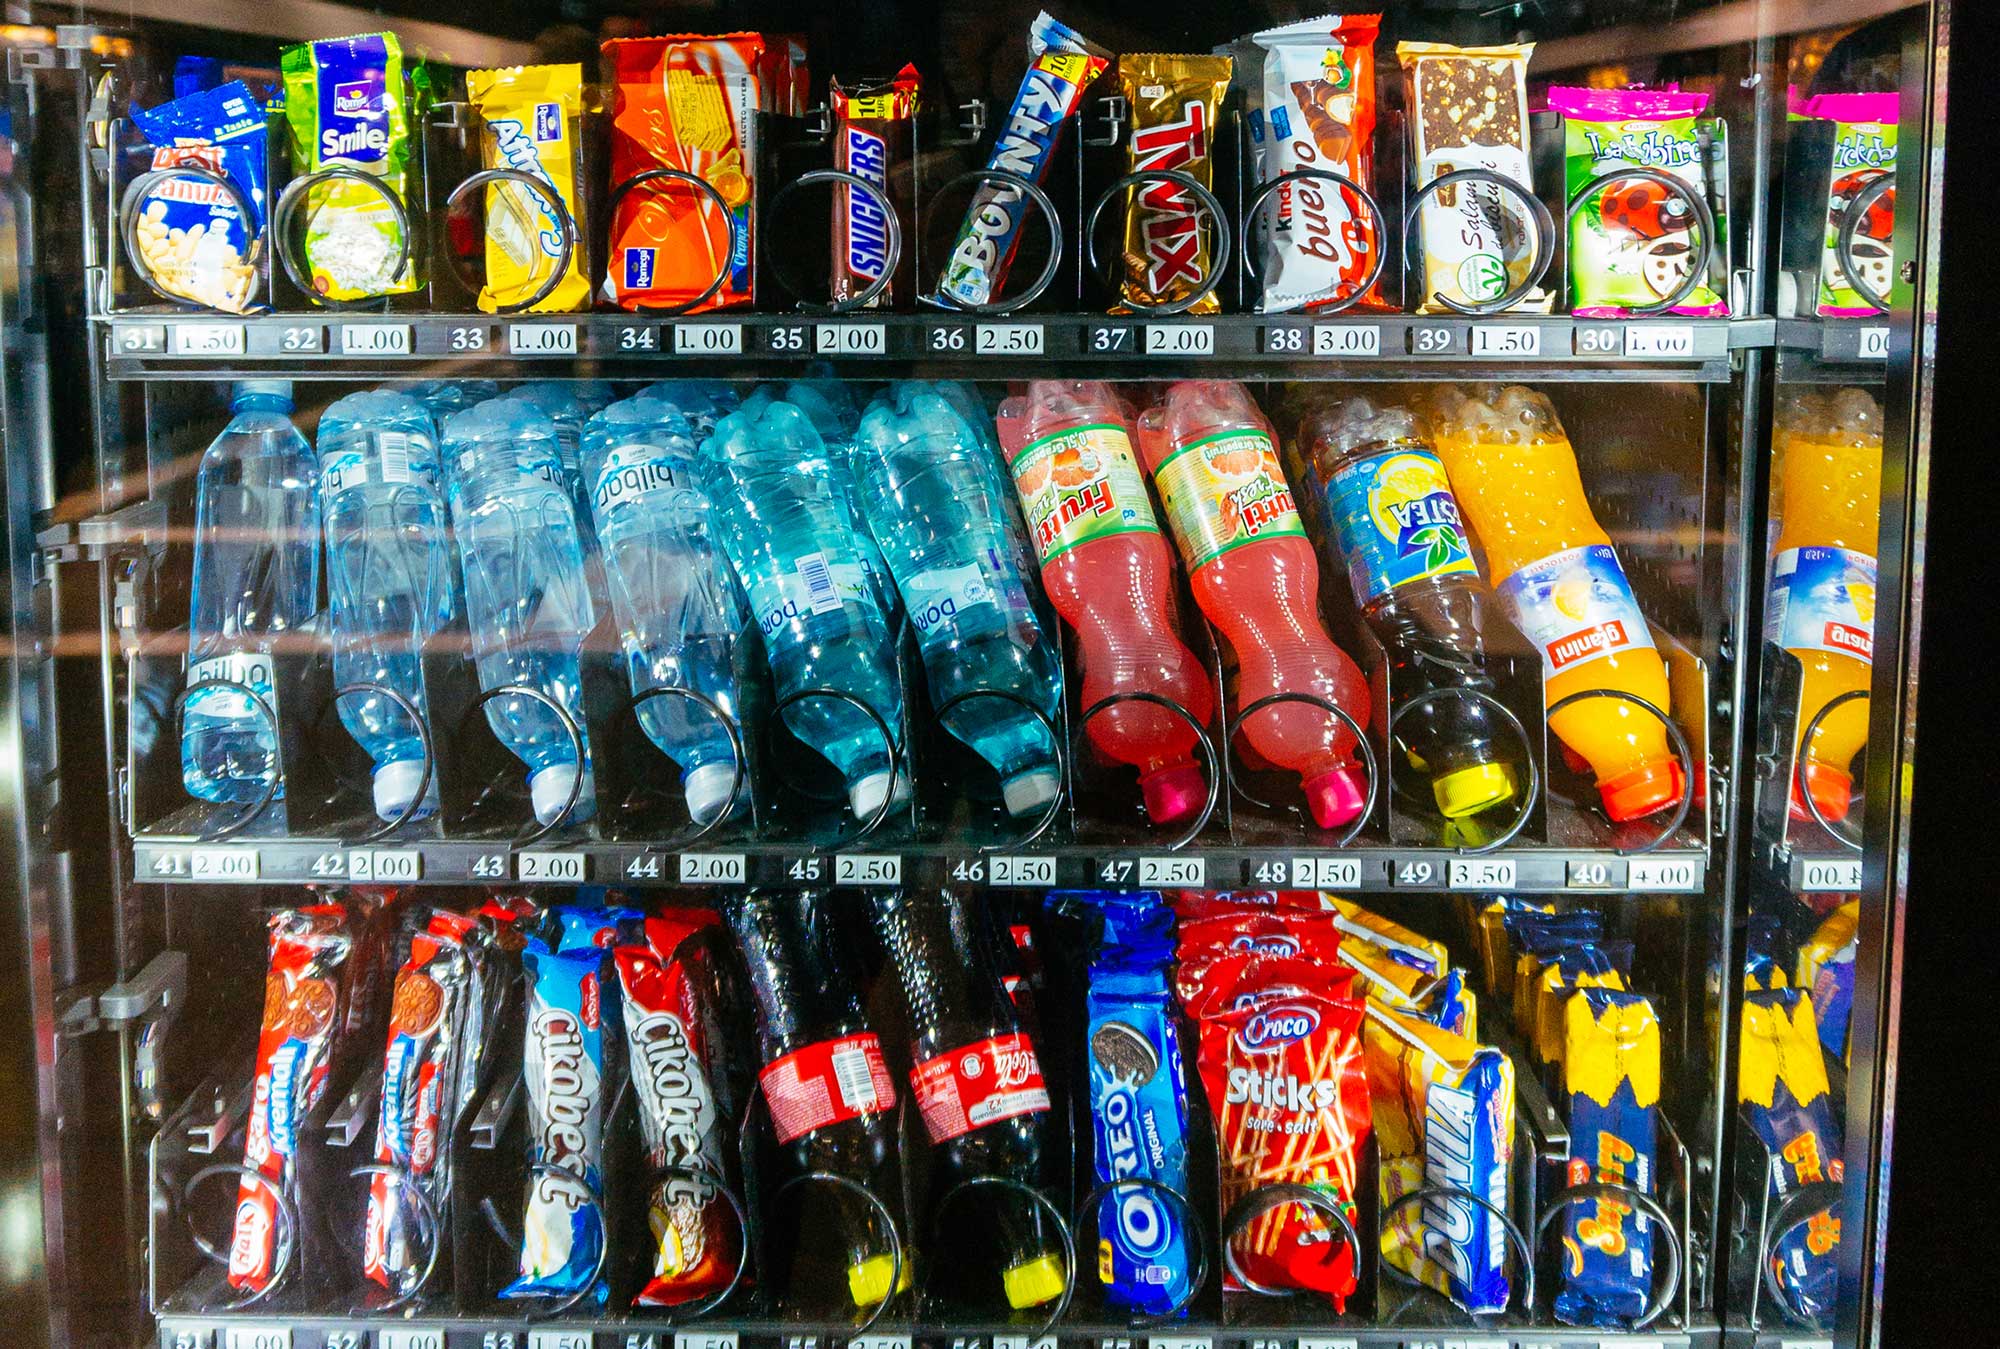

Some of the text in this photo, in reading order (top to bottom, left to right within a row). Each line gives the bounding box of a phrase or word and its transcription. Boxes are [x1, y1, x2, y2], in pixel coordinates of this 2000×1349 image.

[322, 122, 386, 157] Smile
[1132, 100, 1206, 295] TWIX
[1297, 140, 1339, 263] bueno
[733, 224, 748, 266] Orange
[637, 249, 651, 288] Romega
[125, 328, 237, 349] 31 1.50
[283, 328, 316, 349] 32
[452, 328, 483, 349] 33
[620, 328, 733, 349] 34 1.00
[771, 328, 803, 349] 35
[932, 328, 1039, 350] 36 2.50
[1094, 328, 1209, 350] 37 2.00
[1270, 328, 1376, 350] 38 3.00
[1418, 329, 1535, 352] 39 1.50
[1582, 329, 1616, 351] 30
[1231, 470, 1275, 514] fresh
[1037, 478, 1117, 558] Frutti
[1242, 490, 1301, 538] rutti
[1554, 624, 1621, 666] granini
[153, 855, 251, 876] 41 2.00
[311, 855, 412, 877] 42 2.00
[471, 855, 579, 879] 43 2.00
[626, 856, 741, 879] 44 2.00
[788, 857, 897, 880] 45 2.50
[952, 860, 1052, 882] 46 2.50
[1100, 860, 1200, 882] 47 2.50
[1255, 860, 1357, 884] 48 2.50
[1399, 862, 1511, 885] 49 3.50
[1573, 863, 1691, 886] 40 4.00
[1243, 1014, 1311, 1048] Croco
[1225, 1066, 1337, 1115] Sticks
[1246, 1115, 1319, 1136] sare salt
[1141, 1108, 1167, 1170] ORIGINAL
[1106, 1093, 1161, 1250] OREO
[1423, 1085, 1477, 1292] DUNIA
